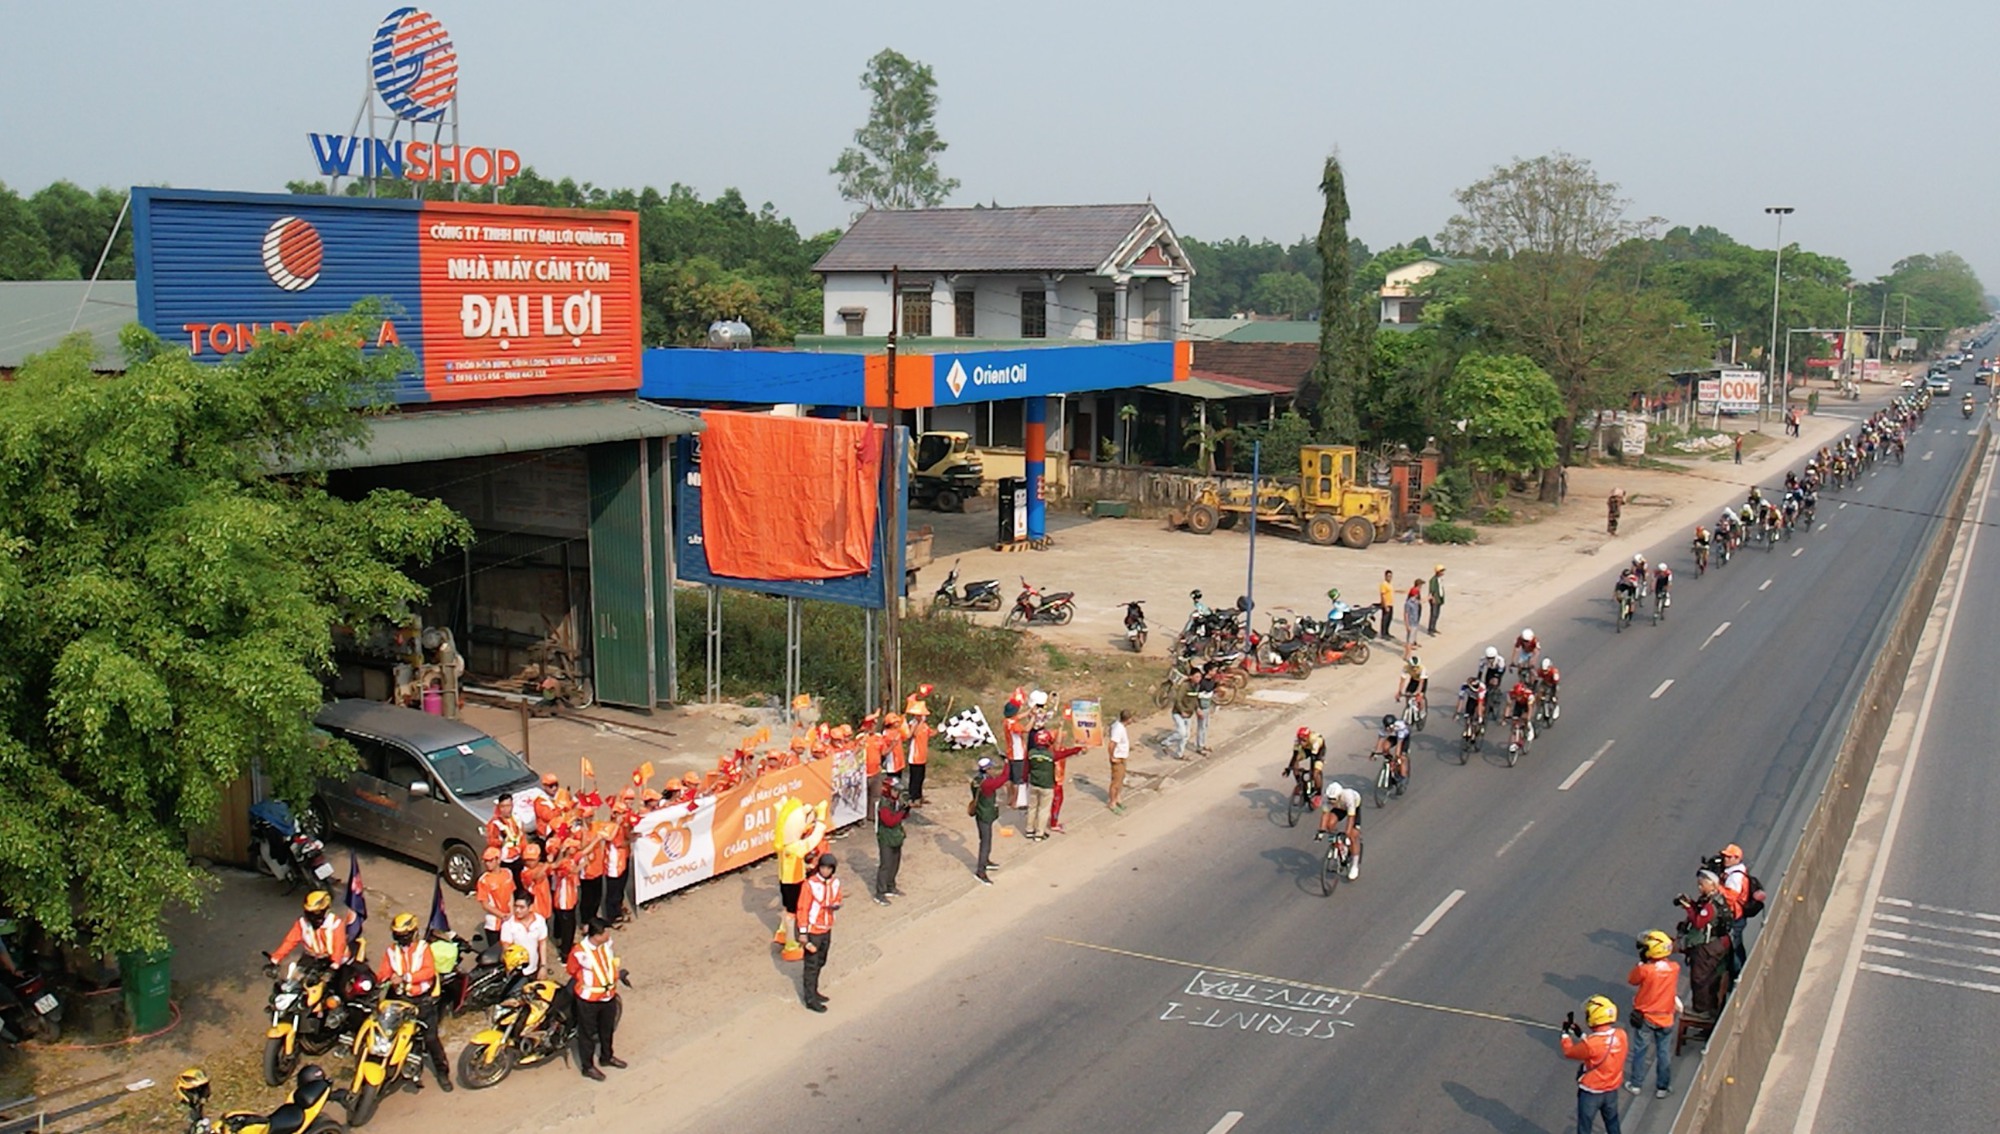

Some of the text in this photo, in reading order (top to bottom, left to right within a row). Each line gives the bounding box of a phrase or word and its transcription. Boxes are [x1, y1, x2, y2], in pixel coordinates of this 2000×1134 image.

[308, 132, 521, 186] WINSHOP
[430, 222, 463, 240] CÔNG
[465, 226, 480, 240] TY
[448, 254, 610, 281] NHÀ MÁY CÁN TÔN
[460, 289, 602, 350] ĐẠI LỢI
[973, 363, 1027, 386] Orient Oil
[744, 807, 771, 831] ĐẠI
[643, 870, 666, 887] TON
[667, 860, 698, 879] DONG
